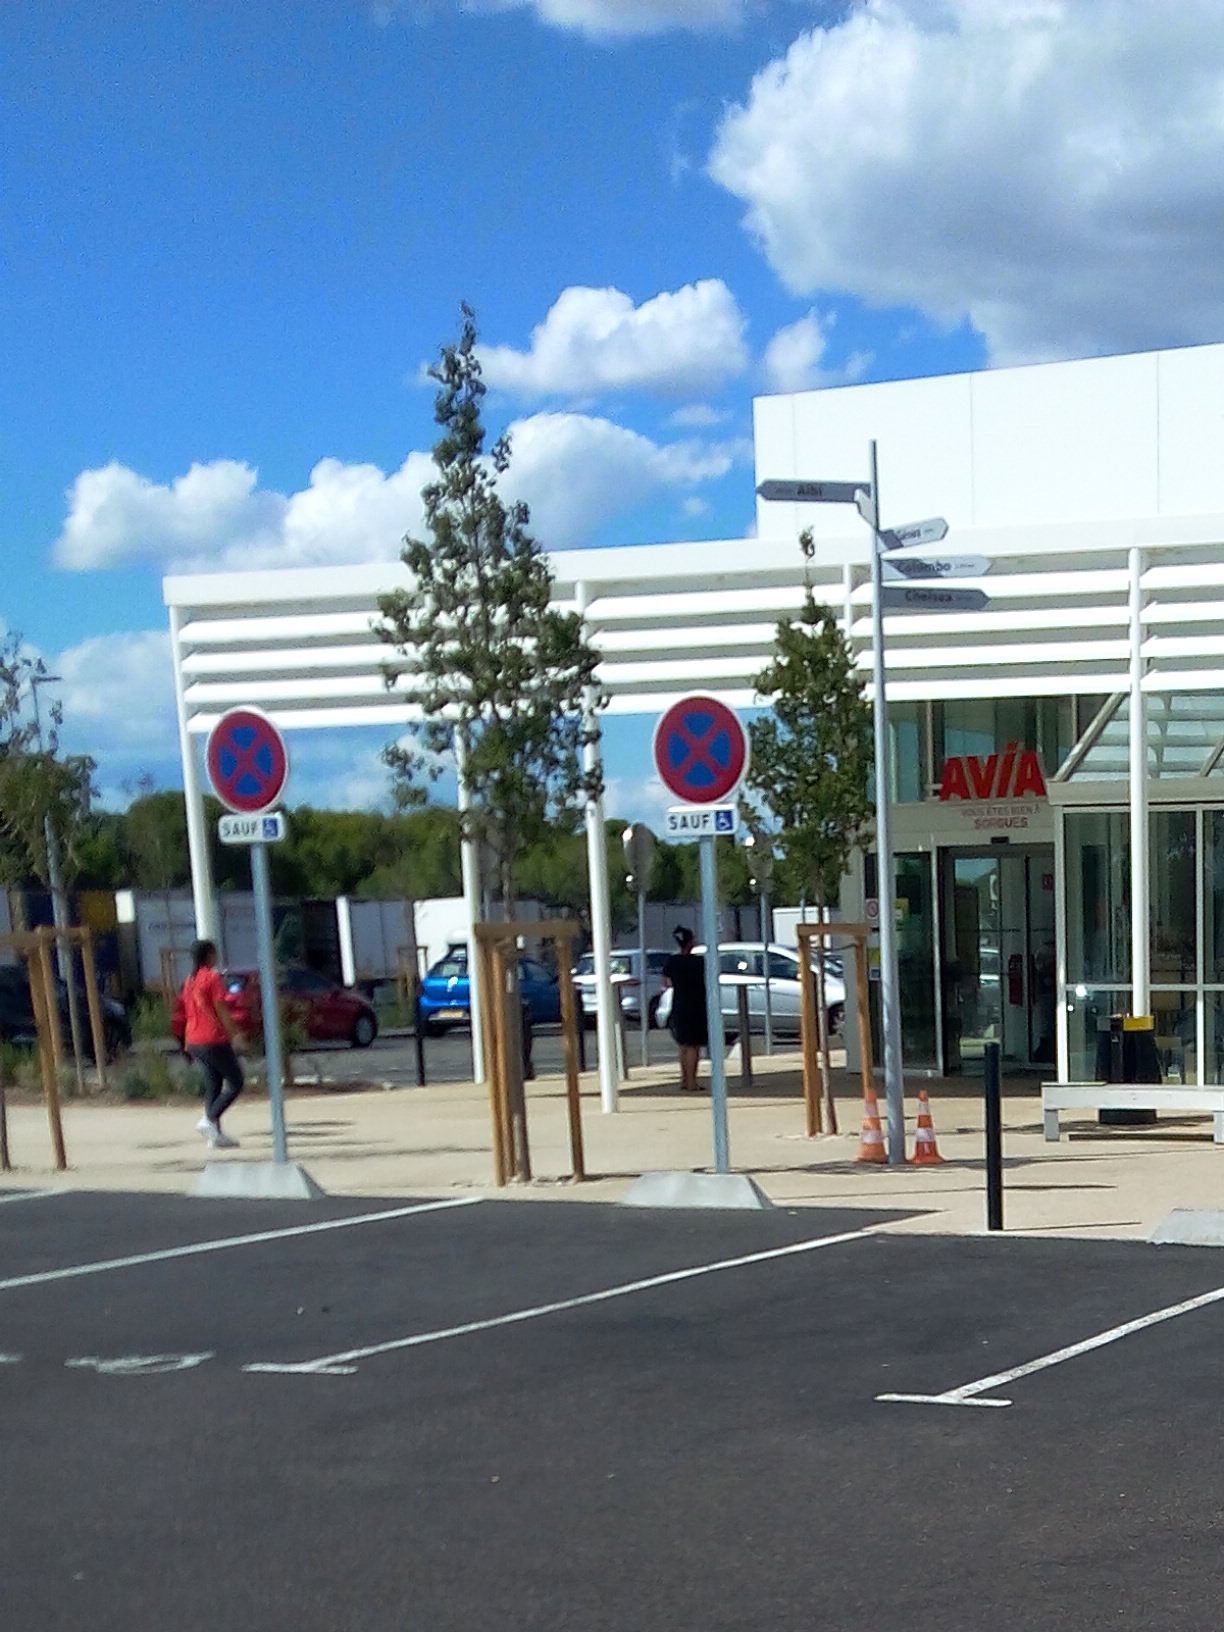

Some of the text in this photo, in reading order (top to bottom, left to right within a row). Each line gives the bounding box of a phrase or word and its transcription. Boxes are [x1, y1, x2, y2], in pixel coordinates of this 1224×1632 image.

[939, 741, 1047, 802] AVIA
[222, 821, 257, 837] SAUF
[668, 814, 711, 830] SAUF
[974, 817, 1028, 829] SORGUES
